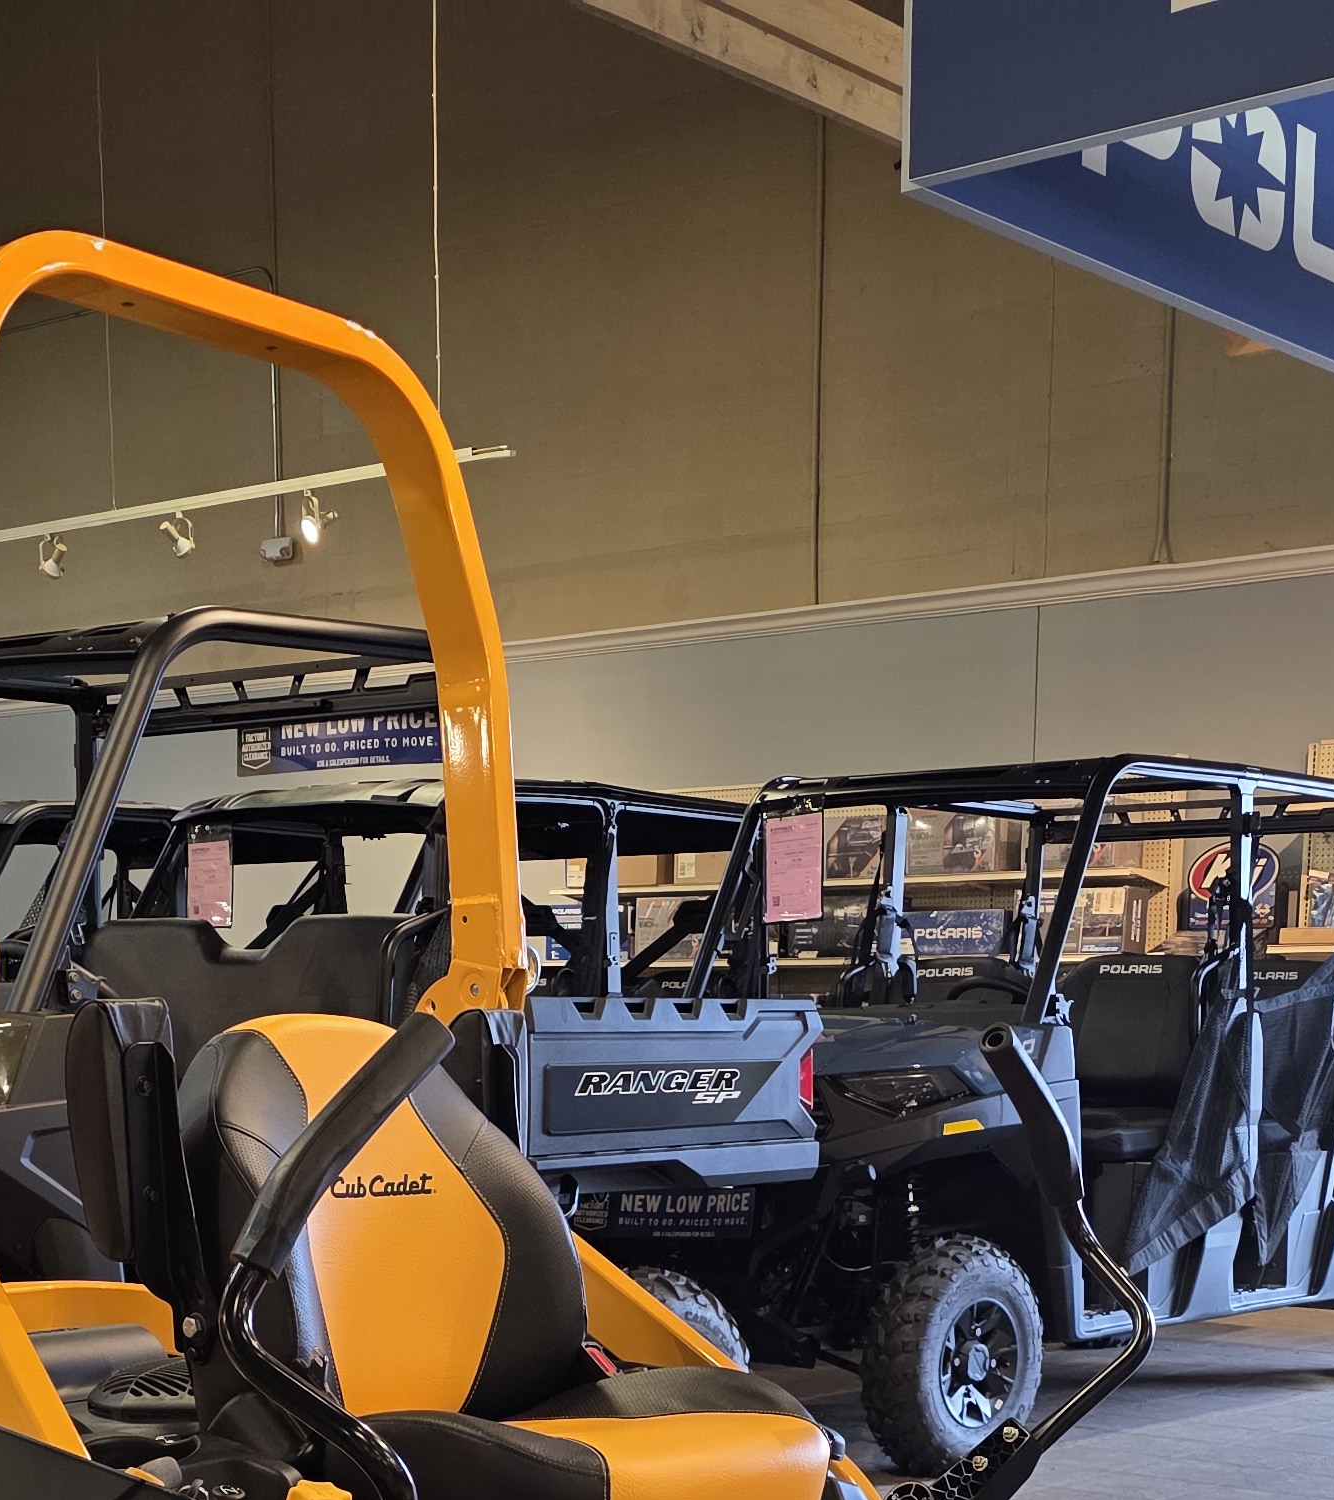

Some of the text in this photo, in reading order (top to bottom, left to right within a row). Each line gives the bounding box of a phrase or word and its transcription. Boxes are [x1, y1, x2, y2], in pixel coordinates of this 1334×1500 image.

[282, 711, 437, 739] NEW LOW PRICE
[280, 744, 306, 757] BUILT
[310, 743, 321, 755] TO
[343, 738, 380, 751] PRICED
[384, 737, 398, 748] TO
[402, 735, 438, 747] MOVE.
[914, 927, 983, 940] POLARIS
[916, 966, 974, 978] POLARIS
[1099, 964, 1163, 975] POLARIS
[1254, 971, 1299, 980] LARIS
[574, 1069, 741, 1096] RANGER
[692, 1091, 741, 1104] SP
[331, 1173, 433, 1198] Cub Cadet
[621, 1192, 751, 1213] NEW LOW PRICE
[619, 1217, 644, 1225] BUILT
[648, 1217, 658, 1226] TO
[679, 1217, 709, 1226] PRICED
[713, 1217, 722, 1225] TO
